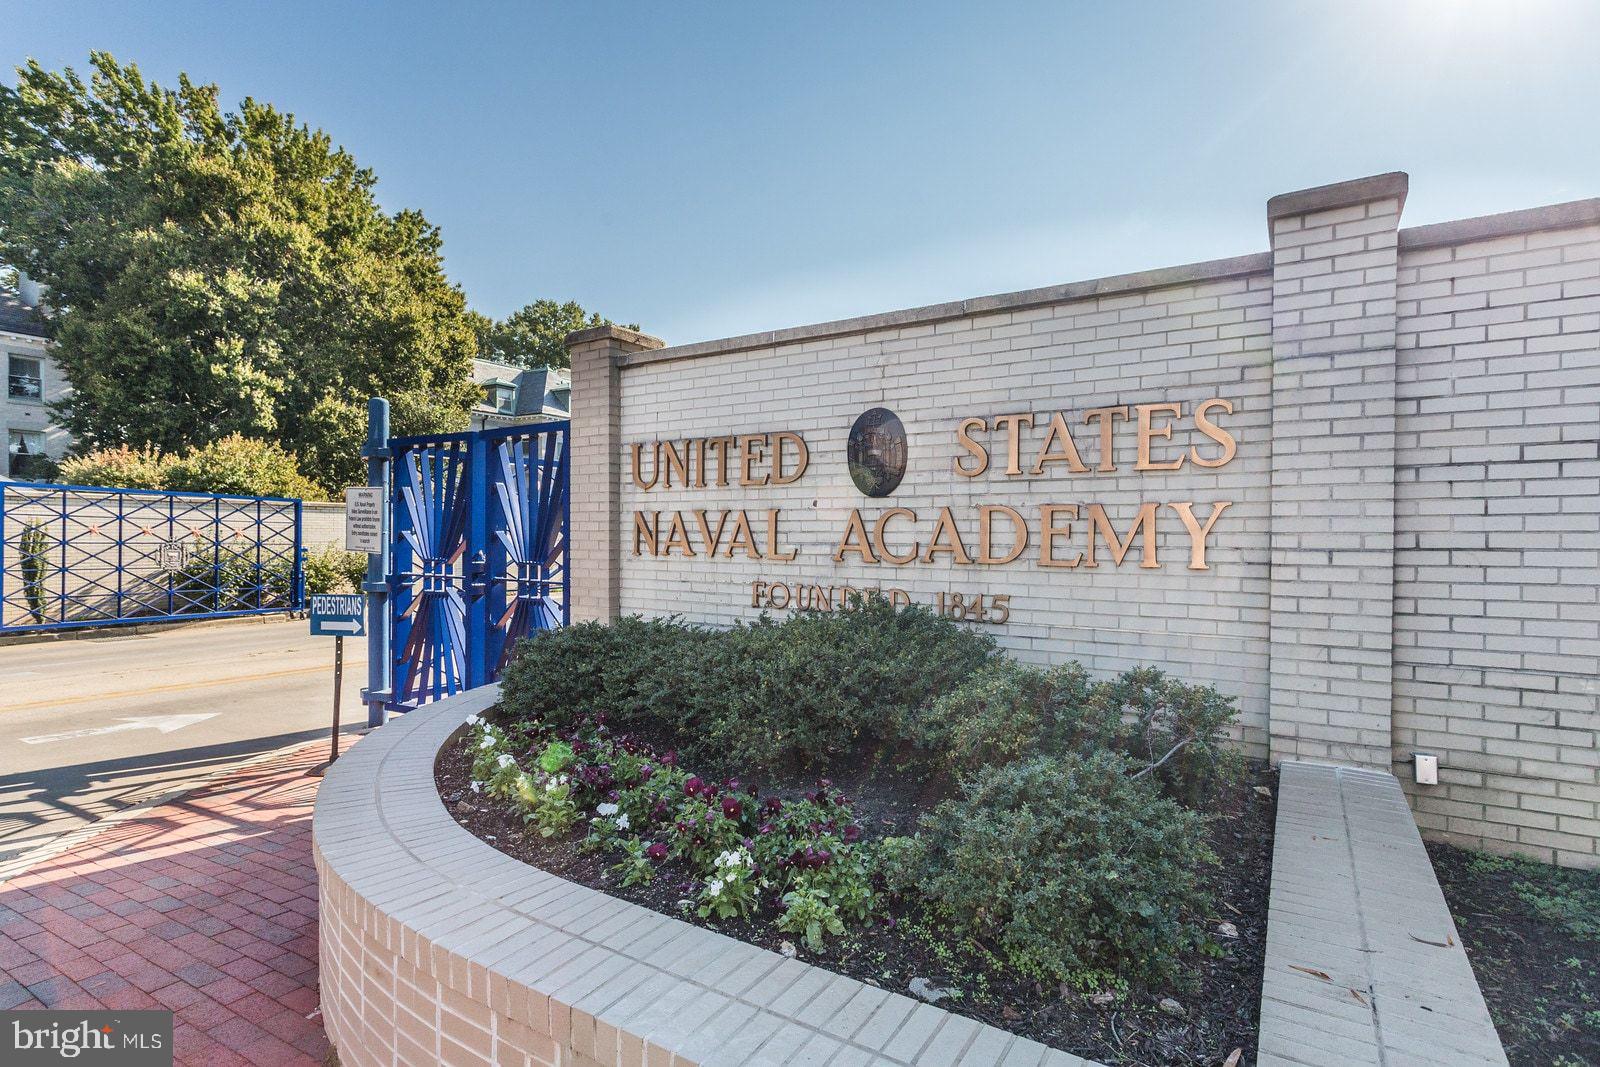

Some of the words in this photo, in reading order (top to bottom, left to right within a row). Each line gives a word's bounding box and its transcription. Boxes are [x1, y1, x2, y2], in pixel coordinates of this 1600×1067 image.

[631, 431, 810, 492] UNITED
[954, 398, 1238, 477] STATES
[633, 508, 798, 562] NAVAL
[833, 501, 1233, 570] ACADEMY
[312, 596, 362, 616] PEDESTRIANS
[936, 591, 1010, 625] 1845
